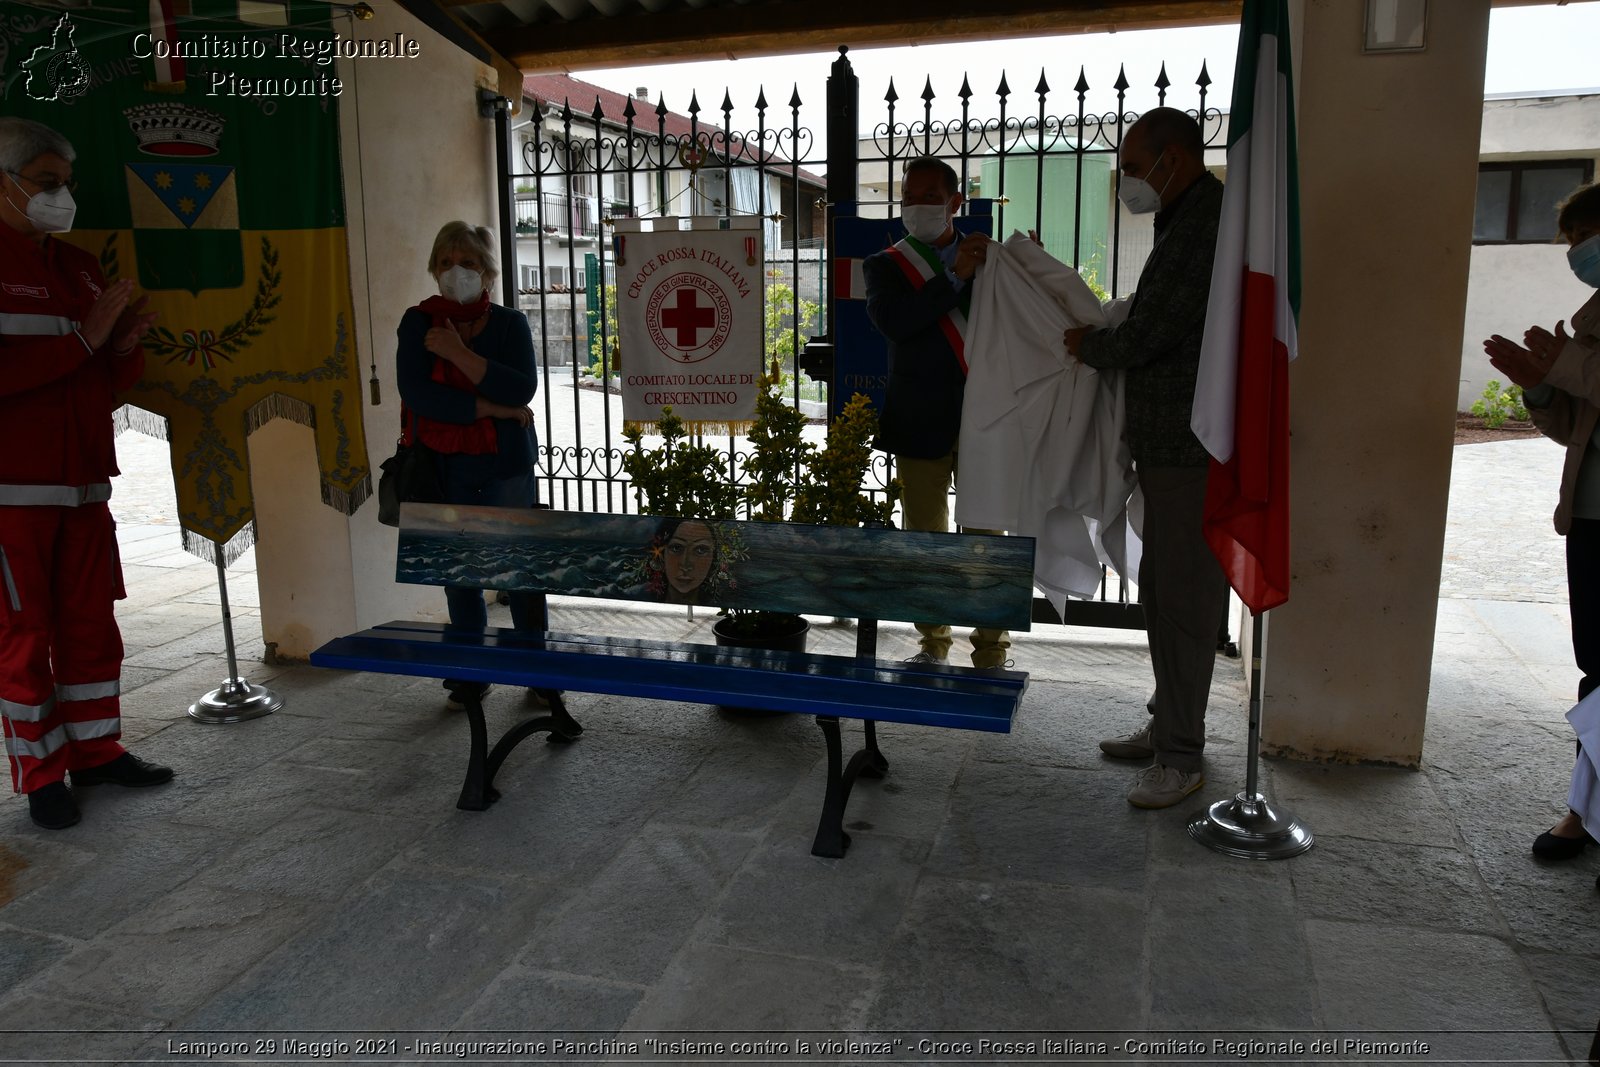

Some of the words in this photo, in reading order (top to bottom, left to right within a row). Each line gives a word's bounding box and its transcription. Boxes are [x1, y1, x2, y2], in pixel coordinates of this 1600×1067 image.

[628, 260, 658, 299] CROCE
[657, 247, 696, 266] ROSSA
[701, 249, 751, 299] ITALIANA
[671, 275, 707, 289] GINEVRA
[708, 284, 720, 296] 22
[648, 289, 669, 351] CONVENZIONE
[717, 295, 730, 333] AGOSTO
[708, 334, 724, 351] 1864
[627, 375, 686, 386] COMITATO
[689, 374, 737, 385] LOCALE
[740, 374, 753, 385] DI
[644, 391, 738, 405] CRESCENTINO
